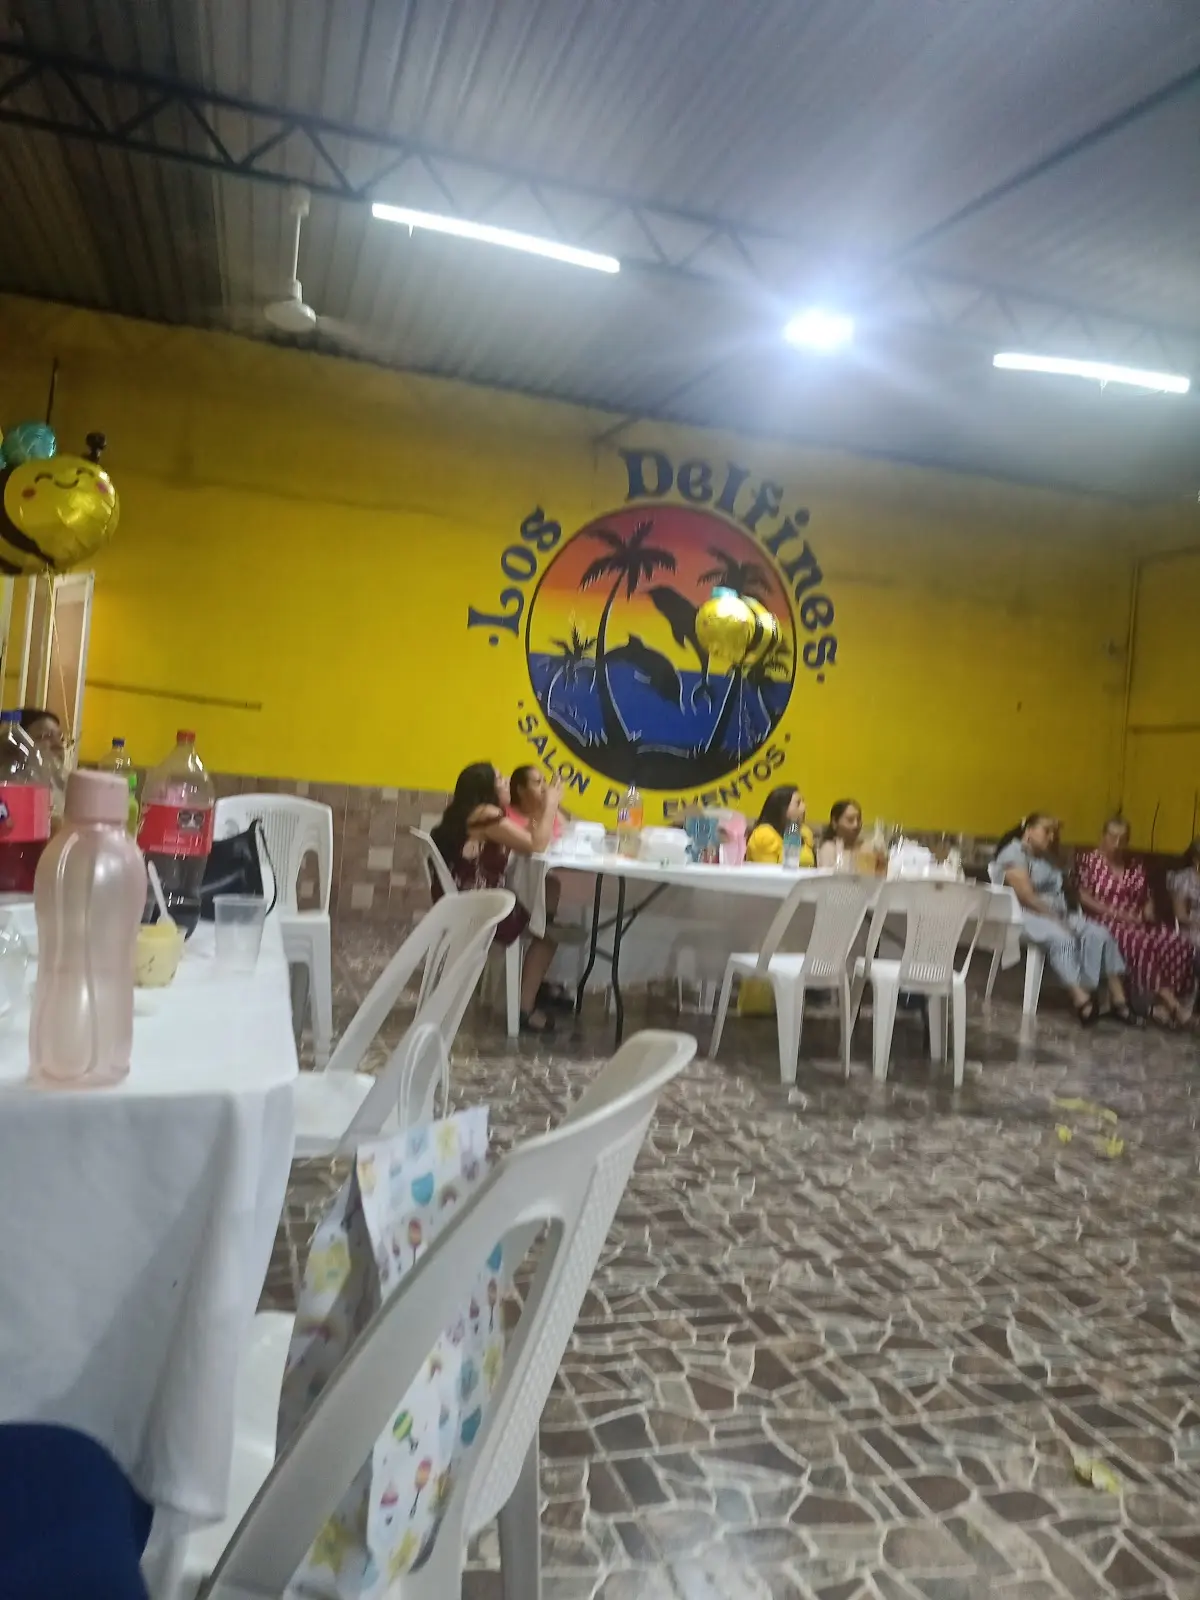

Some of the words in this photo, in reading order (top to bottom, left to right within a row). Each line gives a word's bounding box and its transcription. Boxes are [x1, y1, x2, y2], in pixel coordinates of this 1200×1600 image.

[467, 506, 562, 639] Los
[619, 448, 838, 670] Delfines
[517, 713, 591, 796] SALON
